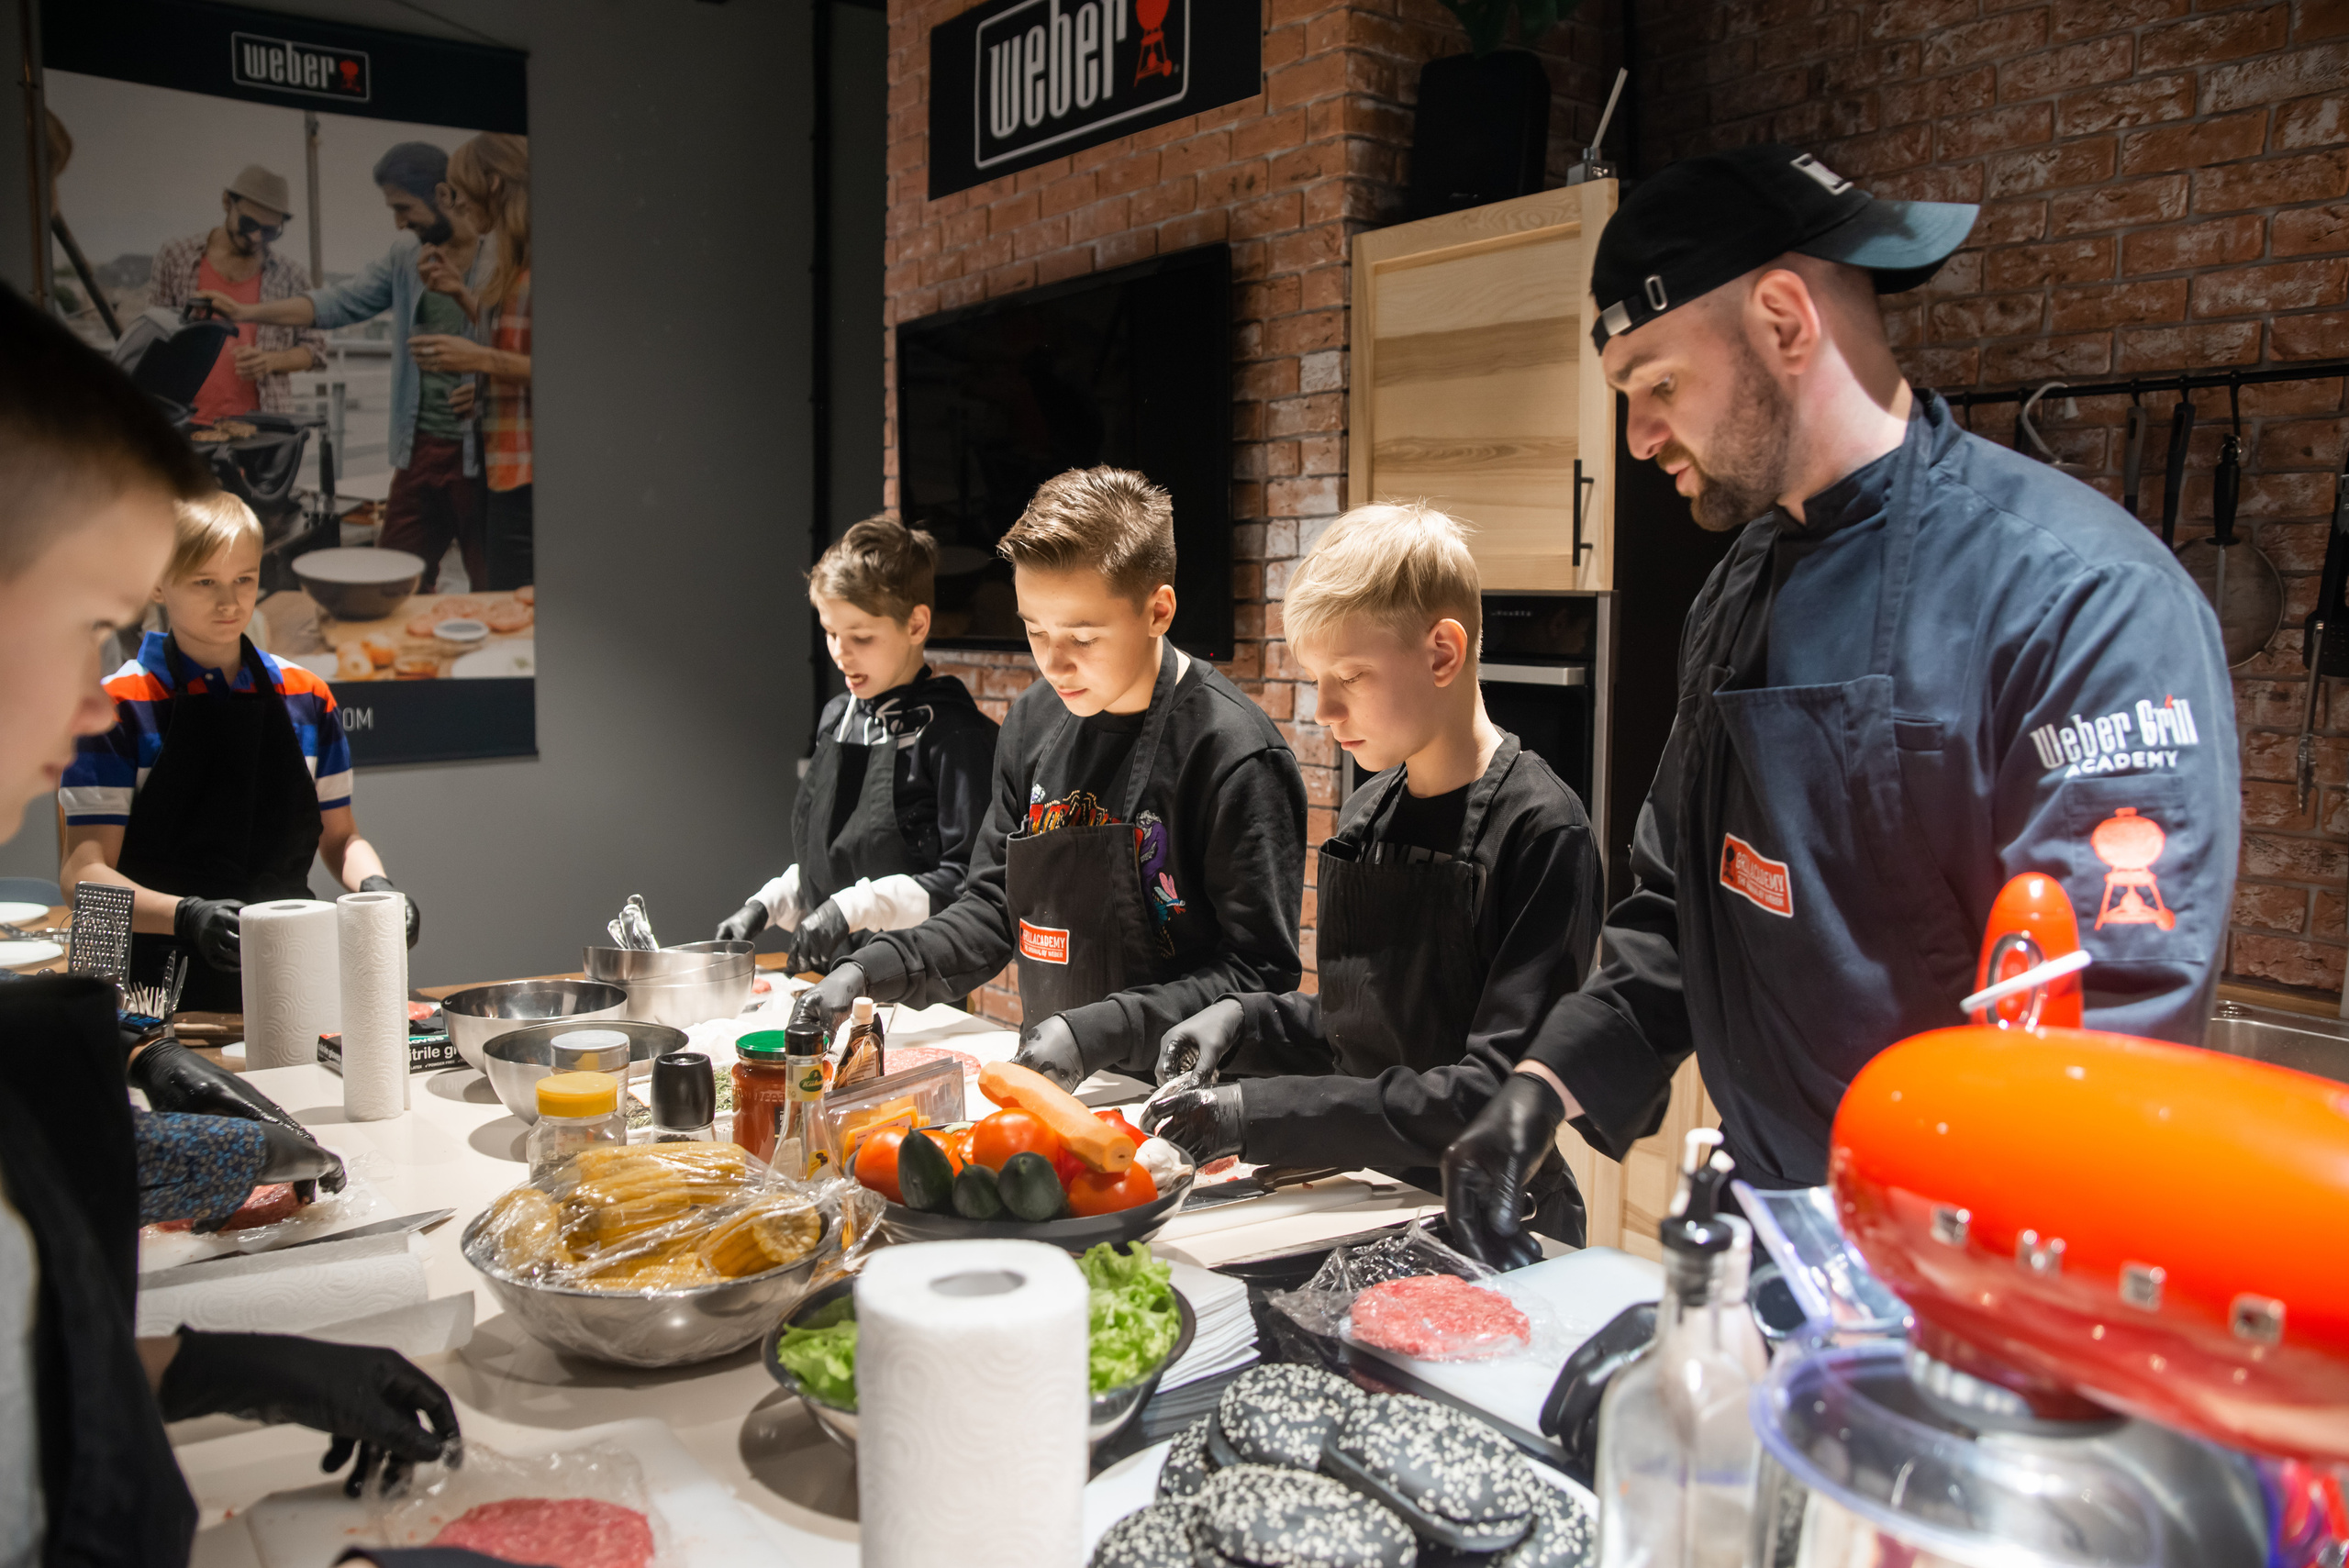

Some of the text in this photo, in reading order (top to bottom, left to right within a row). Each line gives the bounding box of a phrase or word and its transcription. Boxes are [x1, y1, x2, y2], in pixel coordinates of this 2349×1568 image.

[243, 41, 336, 90] weber
[989, 0, 1128, 139] weber
[2029, 695, 2199, 770] Weber Grill
[2065, 751, 2179, 779] ACADEMY
